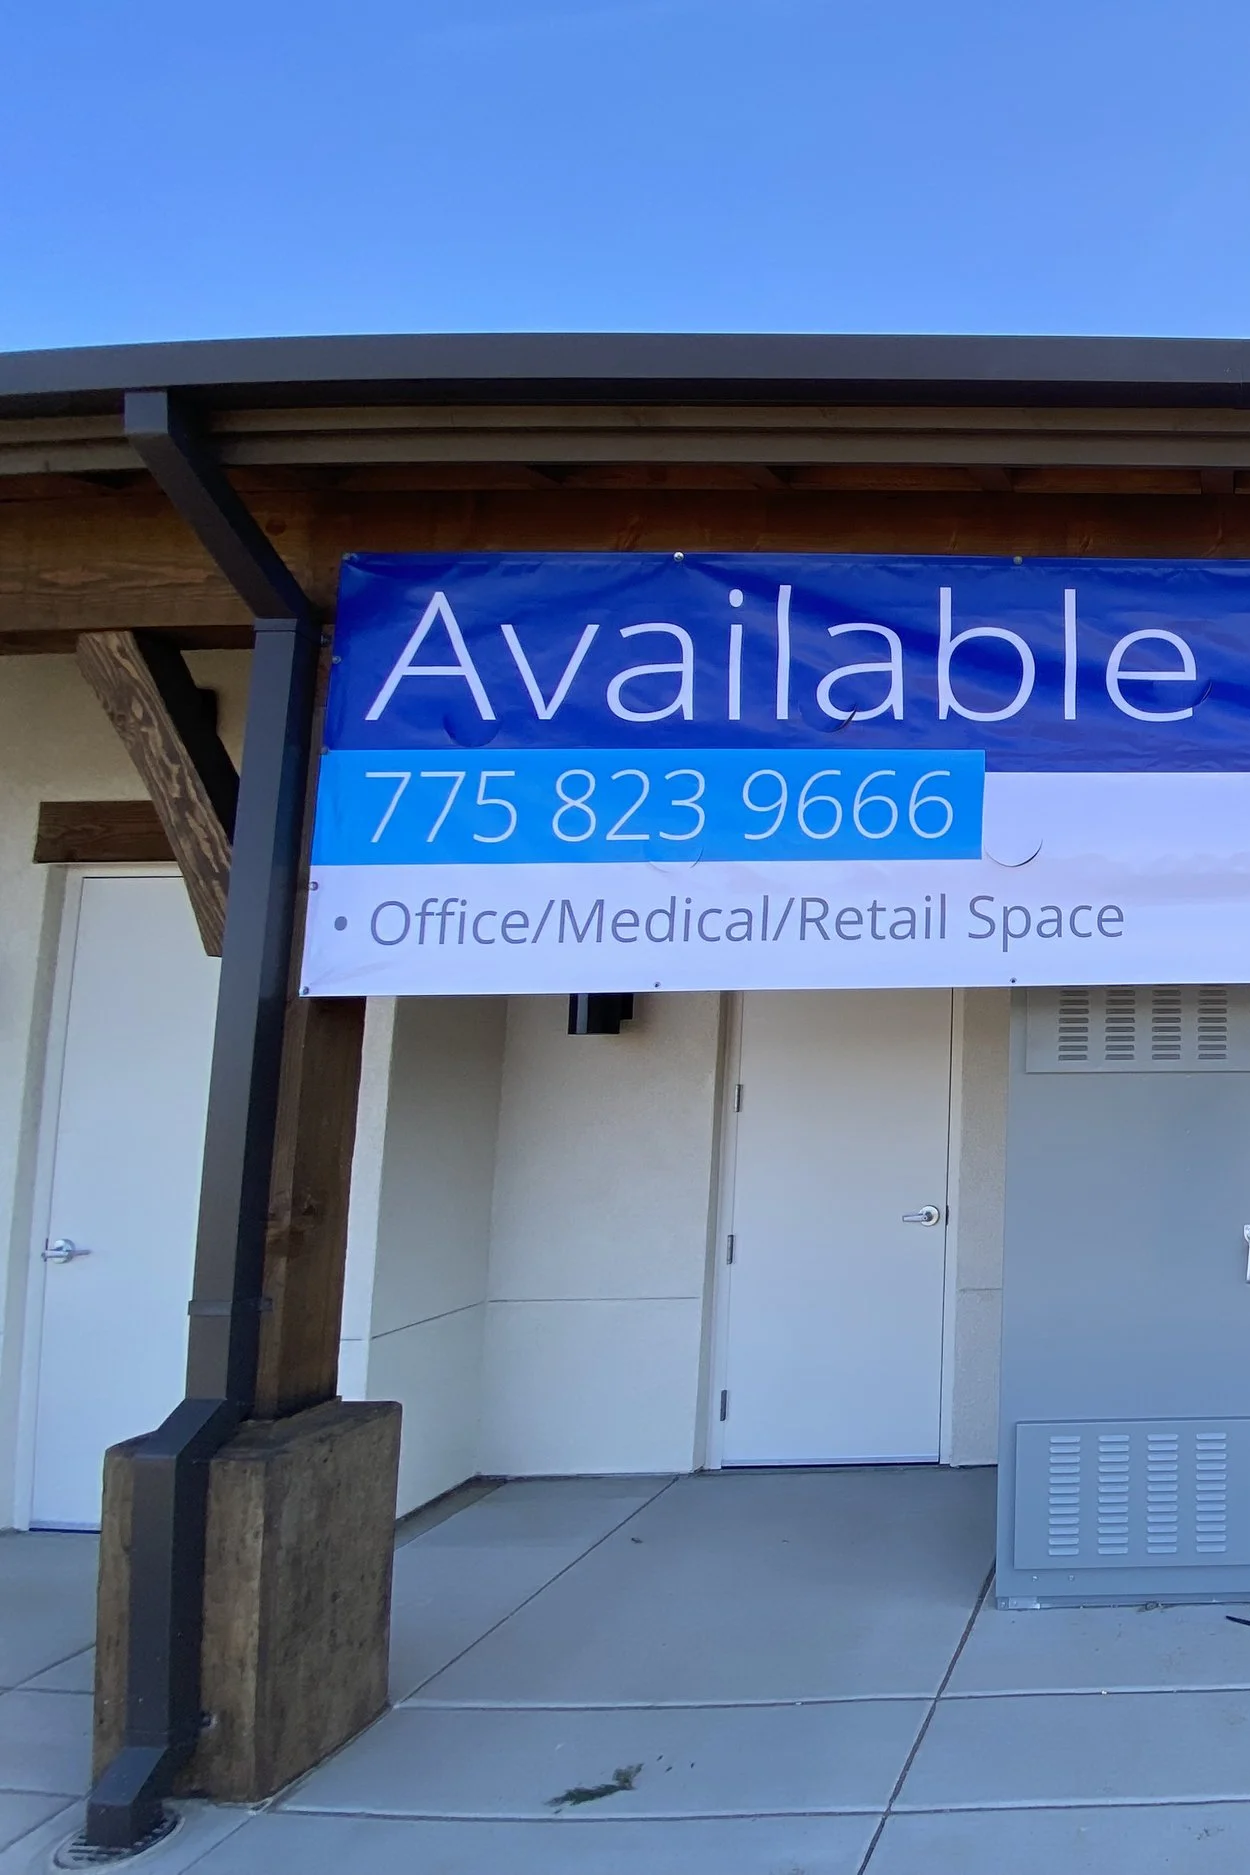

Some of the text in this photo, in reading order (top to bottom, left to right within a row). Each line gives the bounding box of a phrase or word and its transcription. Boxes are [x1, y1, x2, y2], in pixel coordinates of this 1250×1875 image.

[365, 585, 1199, 722] Available
[364, 769, 954, 843] 775 823 9666
[369, 894, 1126, 952] Office/Medical/Retail Space
